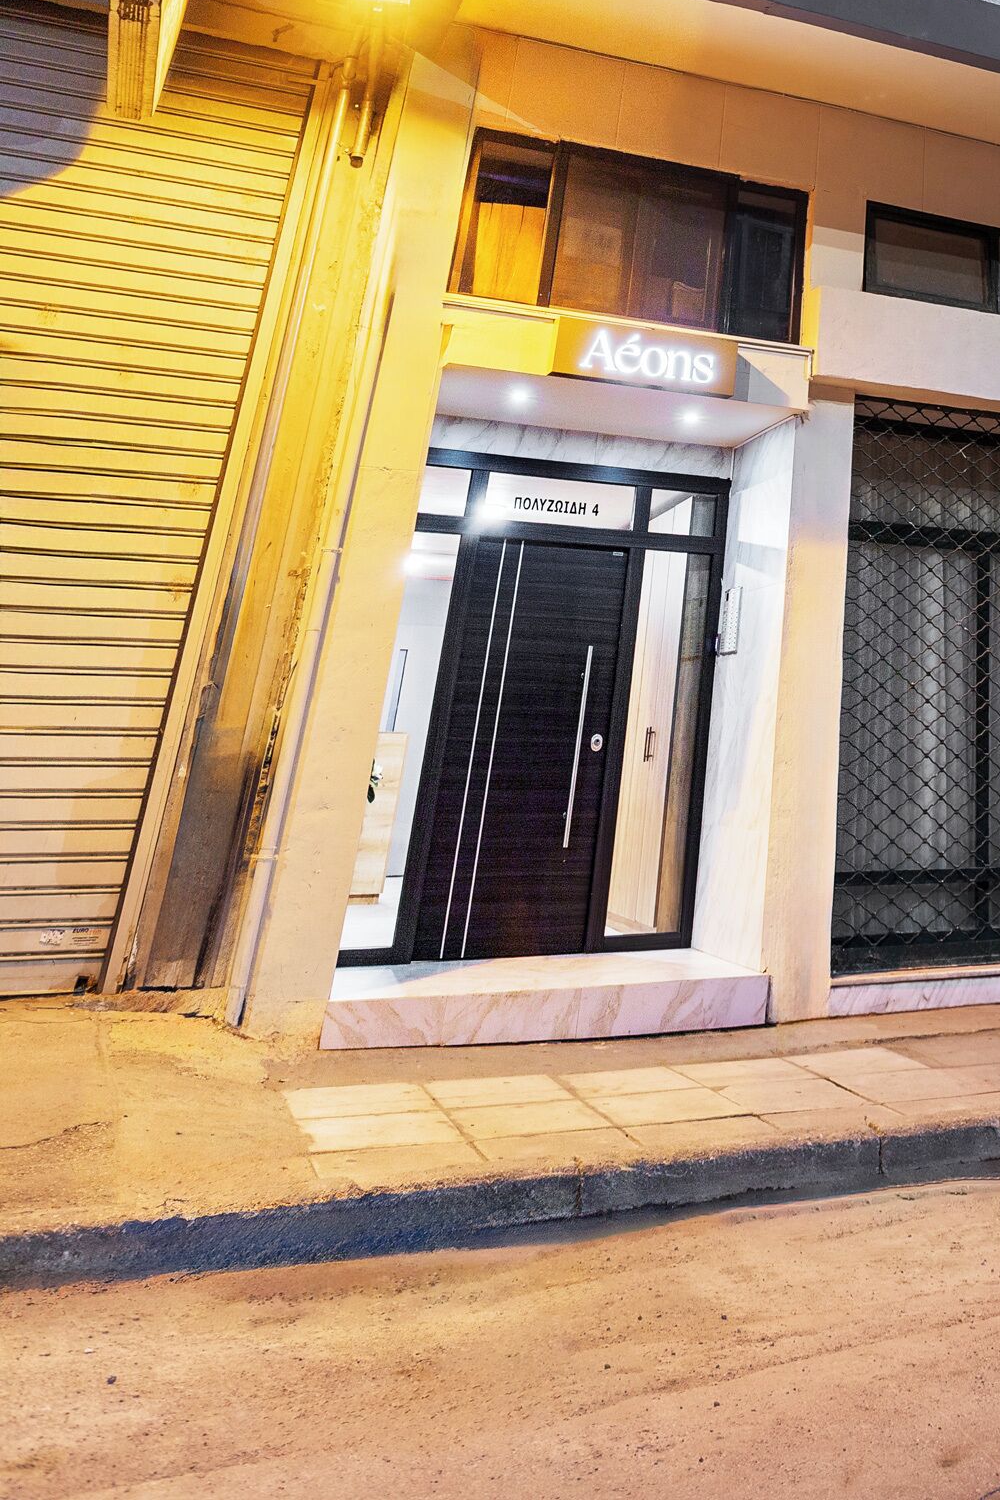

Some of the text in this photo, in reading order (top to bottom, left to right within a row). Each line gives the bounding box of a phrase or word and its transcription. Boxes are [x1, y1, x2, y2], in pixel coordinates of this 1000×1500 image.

[579, 329, 715, 383] Aéons
[513, 496, 600, 517] ΠΟΛΥΖΩΙΔΗ 4
